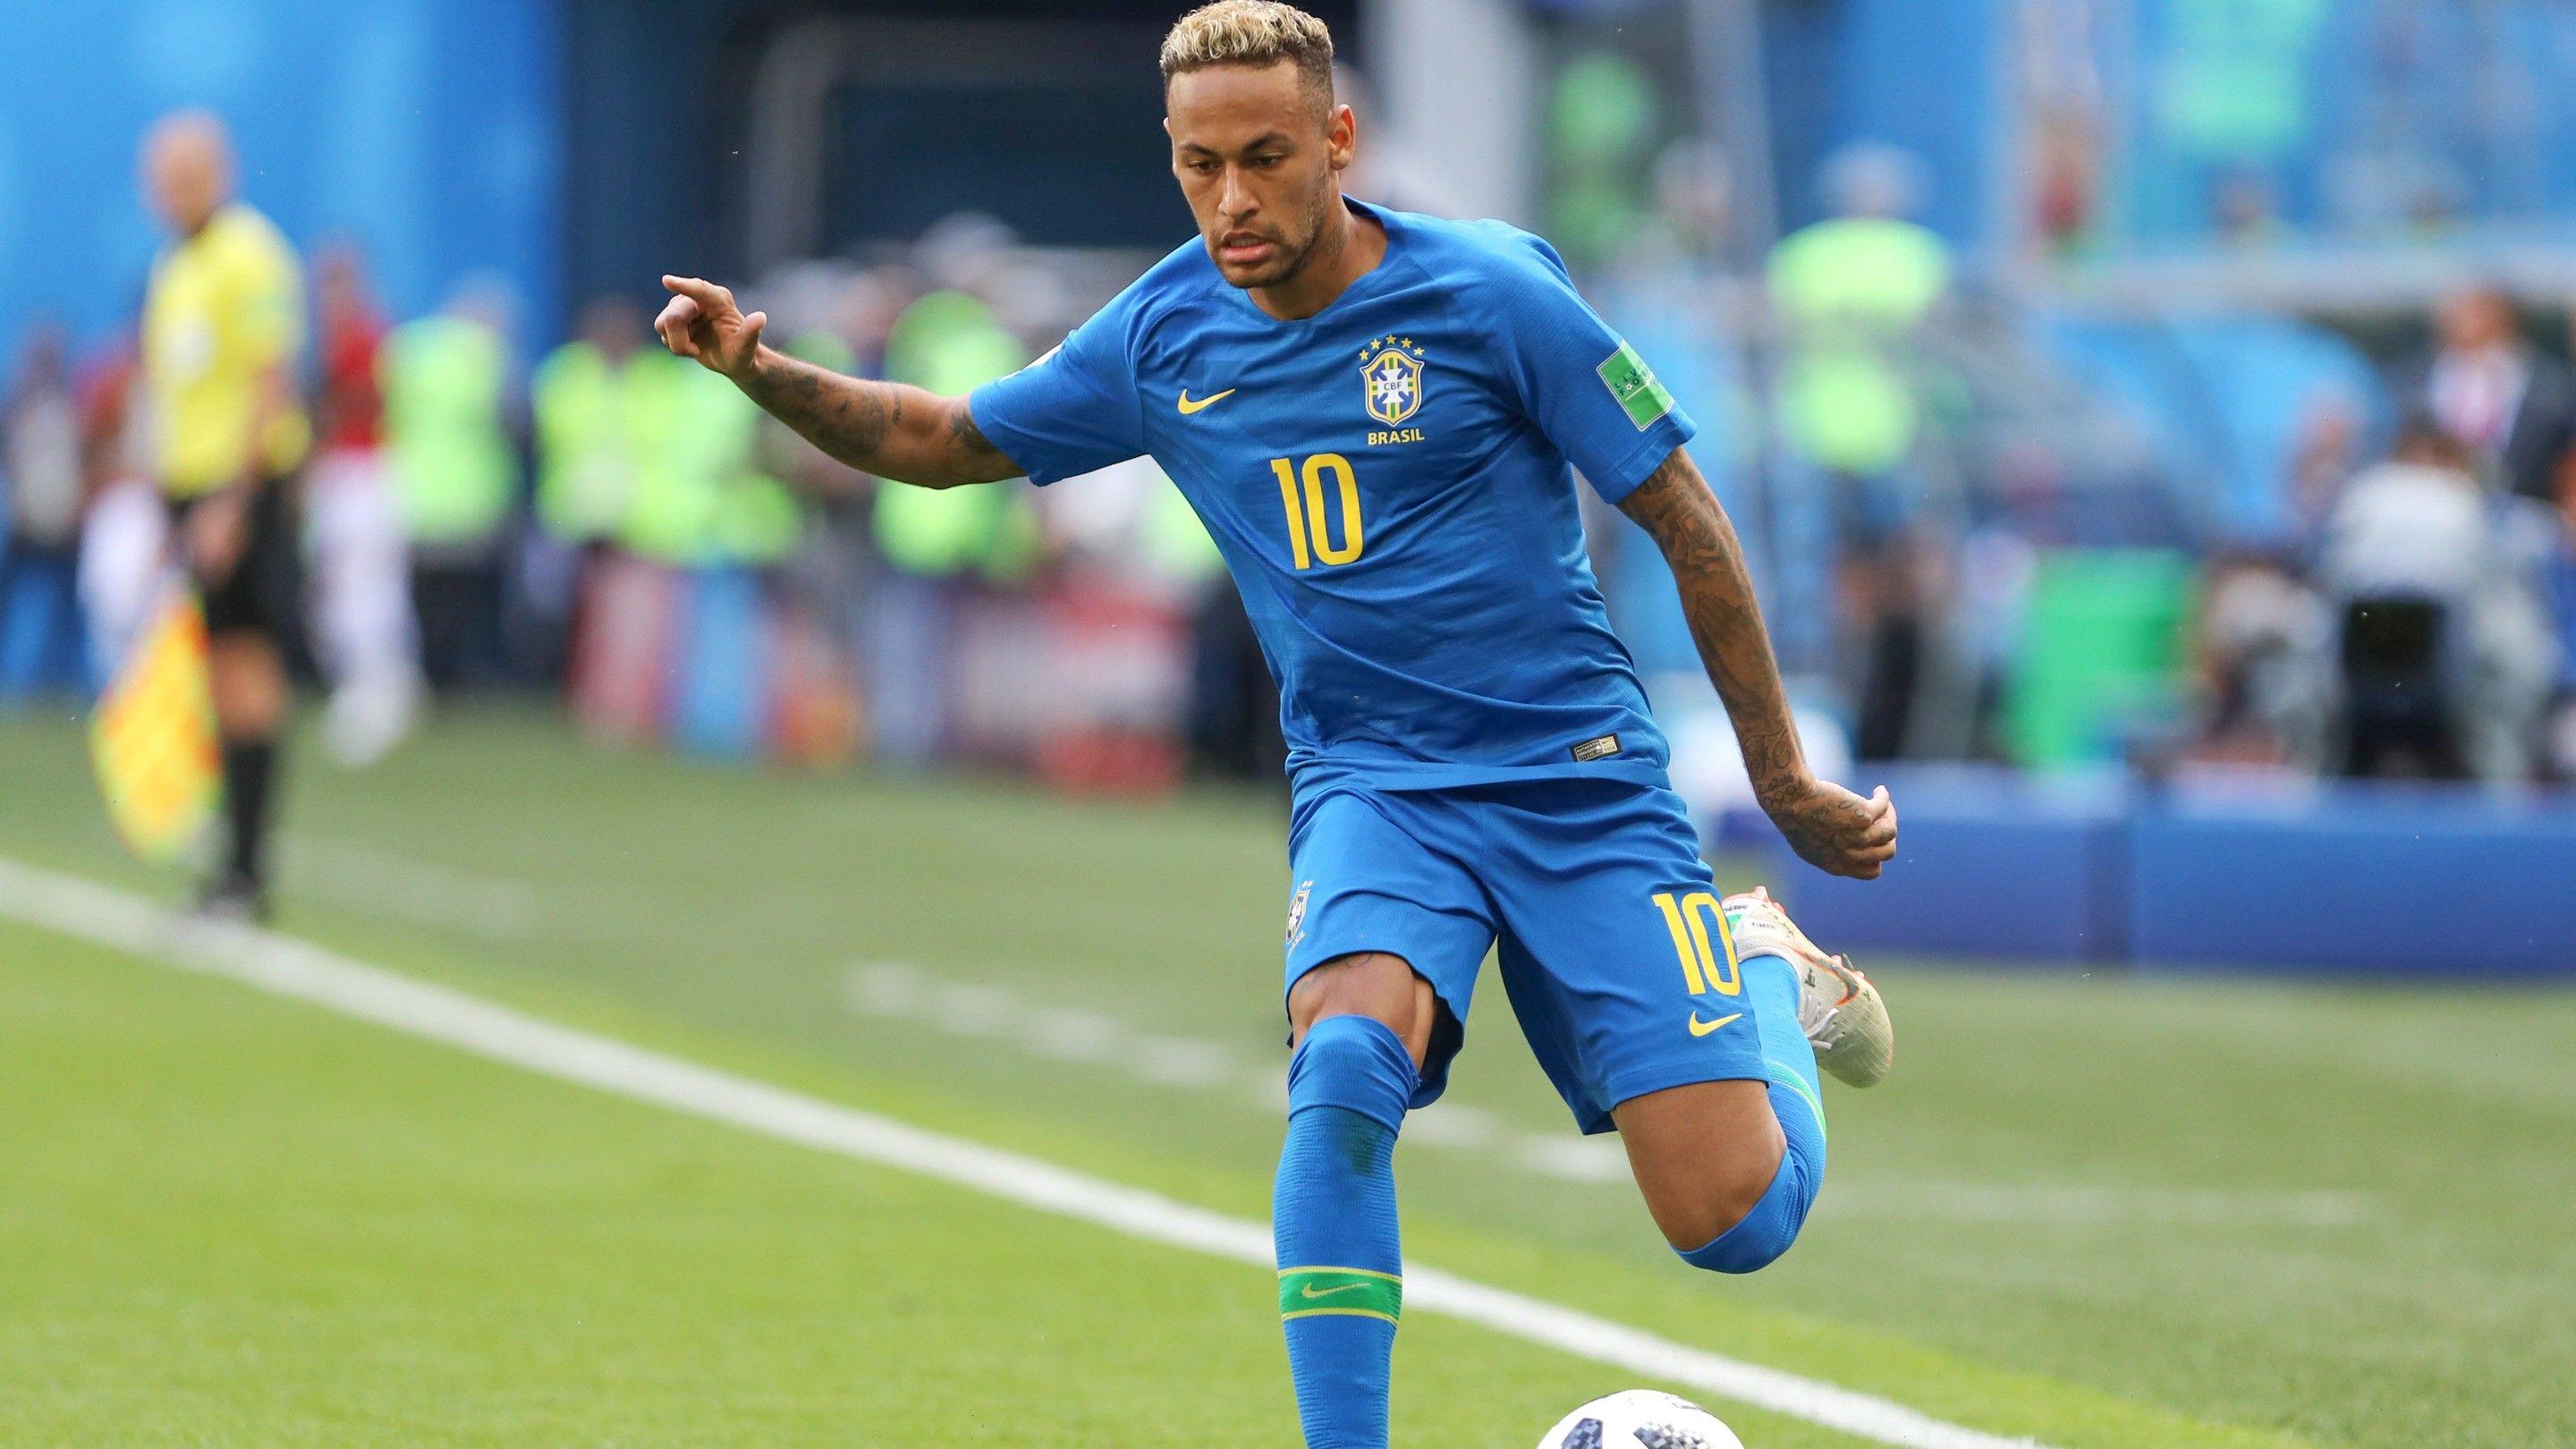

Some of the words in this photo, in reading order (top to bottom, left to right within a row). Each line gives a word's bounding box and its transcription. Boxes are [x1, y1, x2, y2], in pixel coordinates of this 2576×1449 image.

[1383, 381, 1402, 392] CBF
[1368, 428, 1425, 445] BRASIL
[1271, 453, 1364, 570] 10
[1651, 893, 1741, 996] 10
